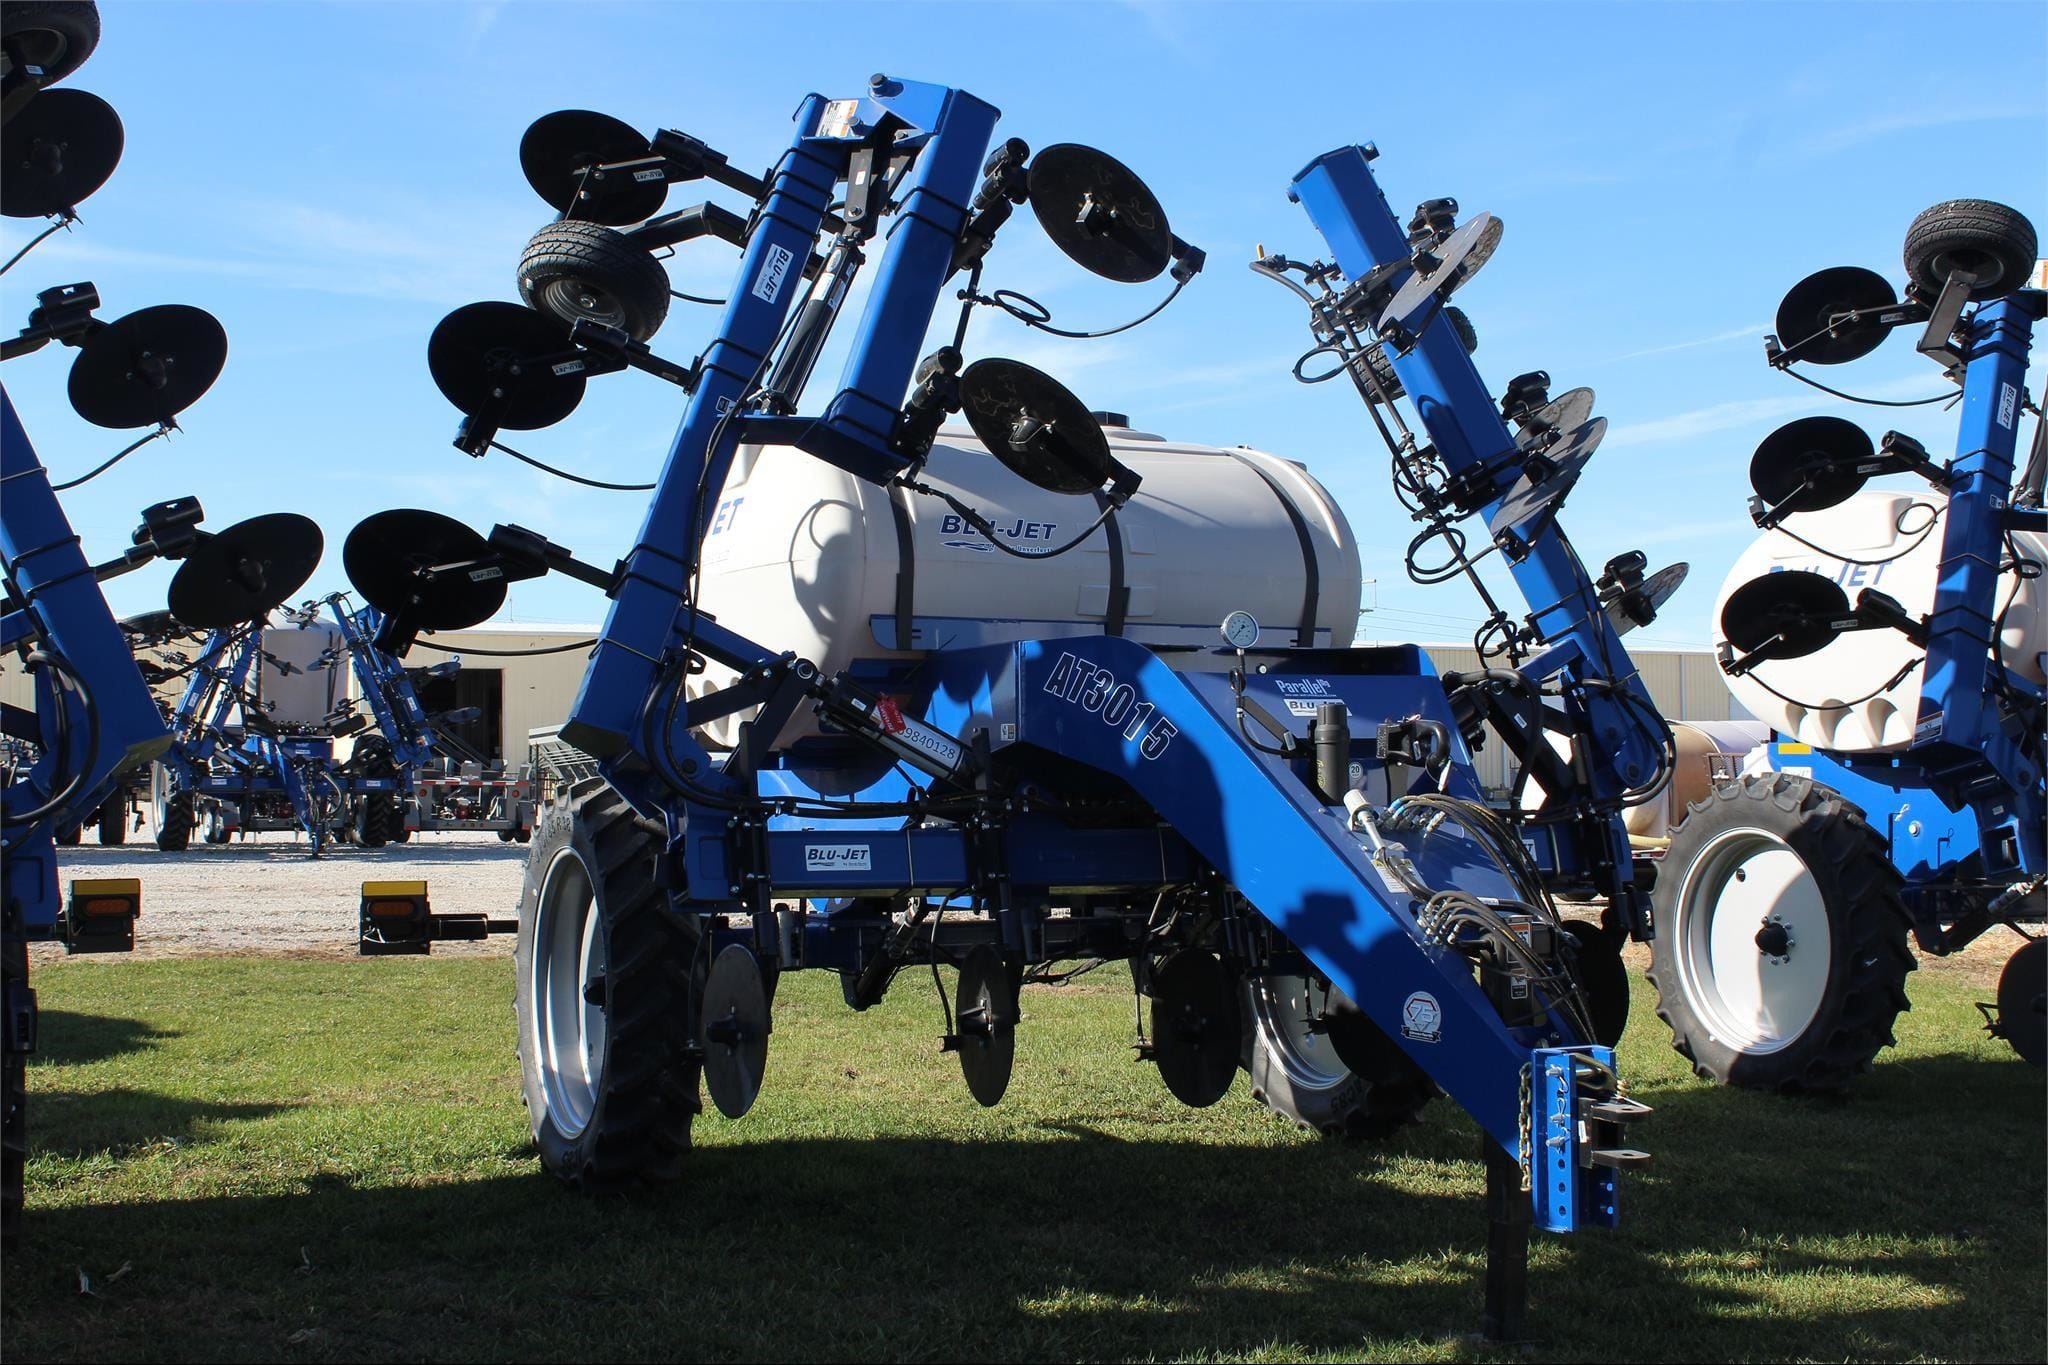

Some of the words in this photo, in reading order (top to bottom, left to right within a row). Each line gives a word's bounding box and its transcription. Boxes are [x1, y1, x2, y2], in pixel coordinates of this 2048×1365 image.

[763, 249, 789, 301] BLU-JET
[1043, 651, 1179, 760] AT3015
[1351, 765, 1360, 773] 20
[808, 848, 868, 860] BLU-JET
